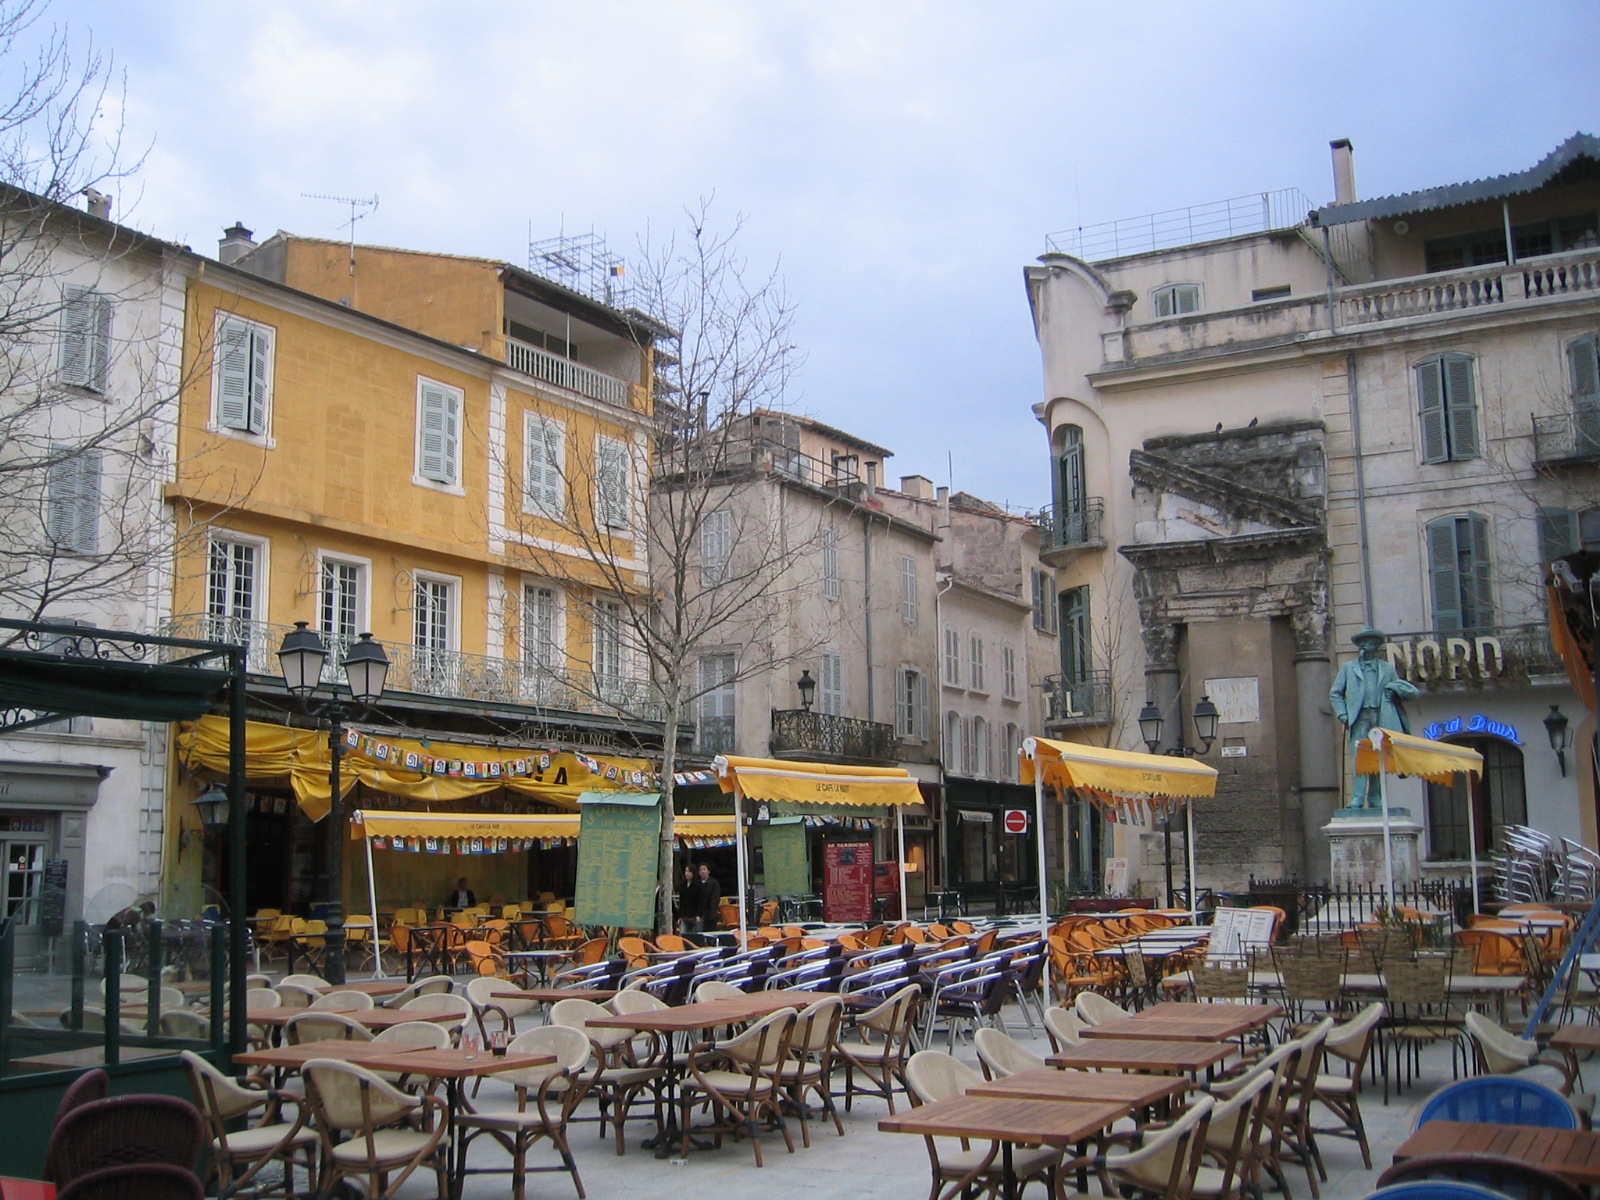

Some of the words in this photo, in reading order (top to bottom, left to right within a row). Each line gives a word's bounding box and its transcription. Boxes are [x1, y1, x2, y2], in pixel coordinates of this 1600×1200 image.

[1386, 636, 1503, 681] NORD
[1424, 716, 1461, 740] Nord
[349, 732, 358, 745] 51
[378, 744, 388, 757] 51
[408, 754, 418, 767] 51
[436, 760, 446, 772] 51
[466, 763, 476, 775] 51
[491, 763, 500, 775] 51
[427, 839, 437, 850] 51
[472, 840, 482, 851] 51
